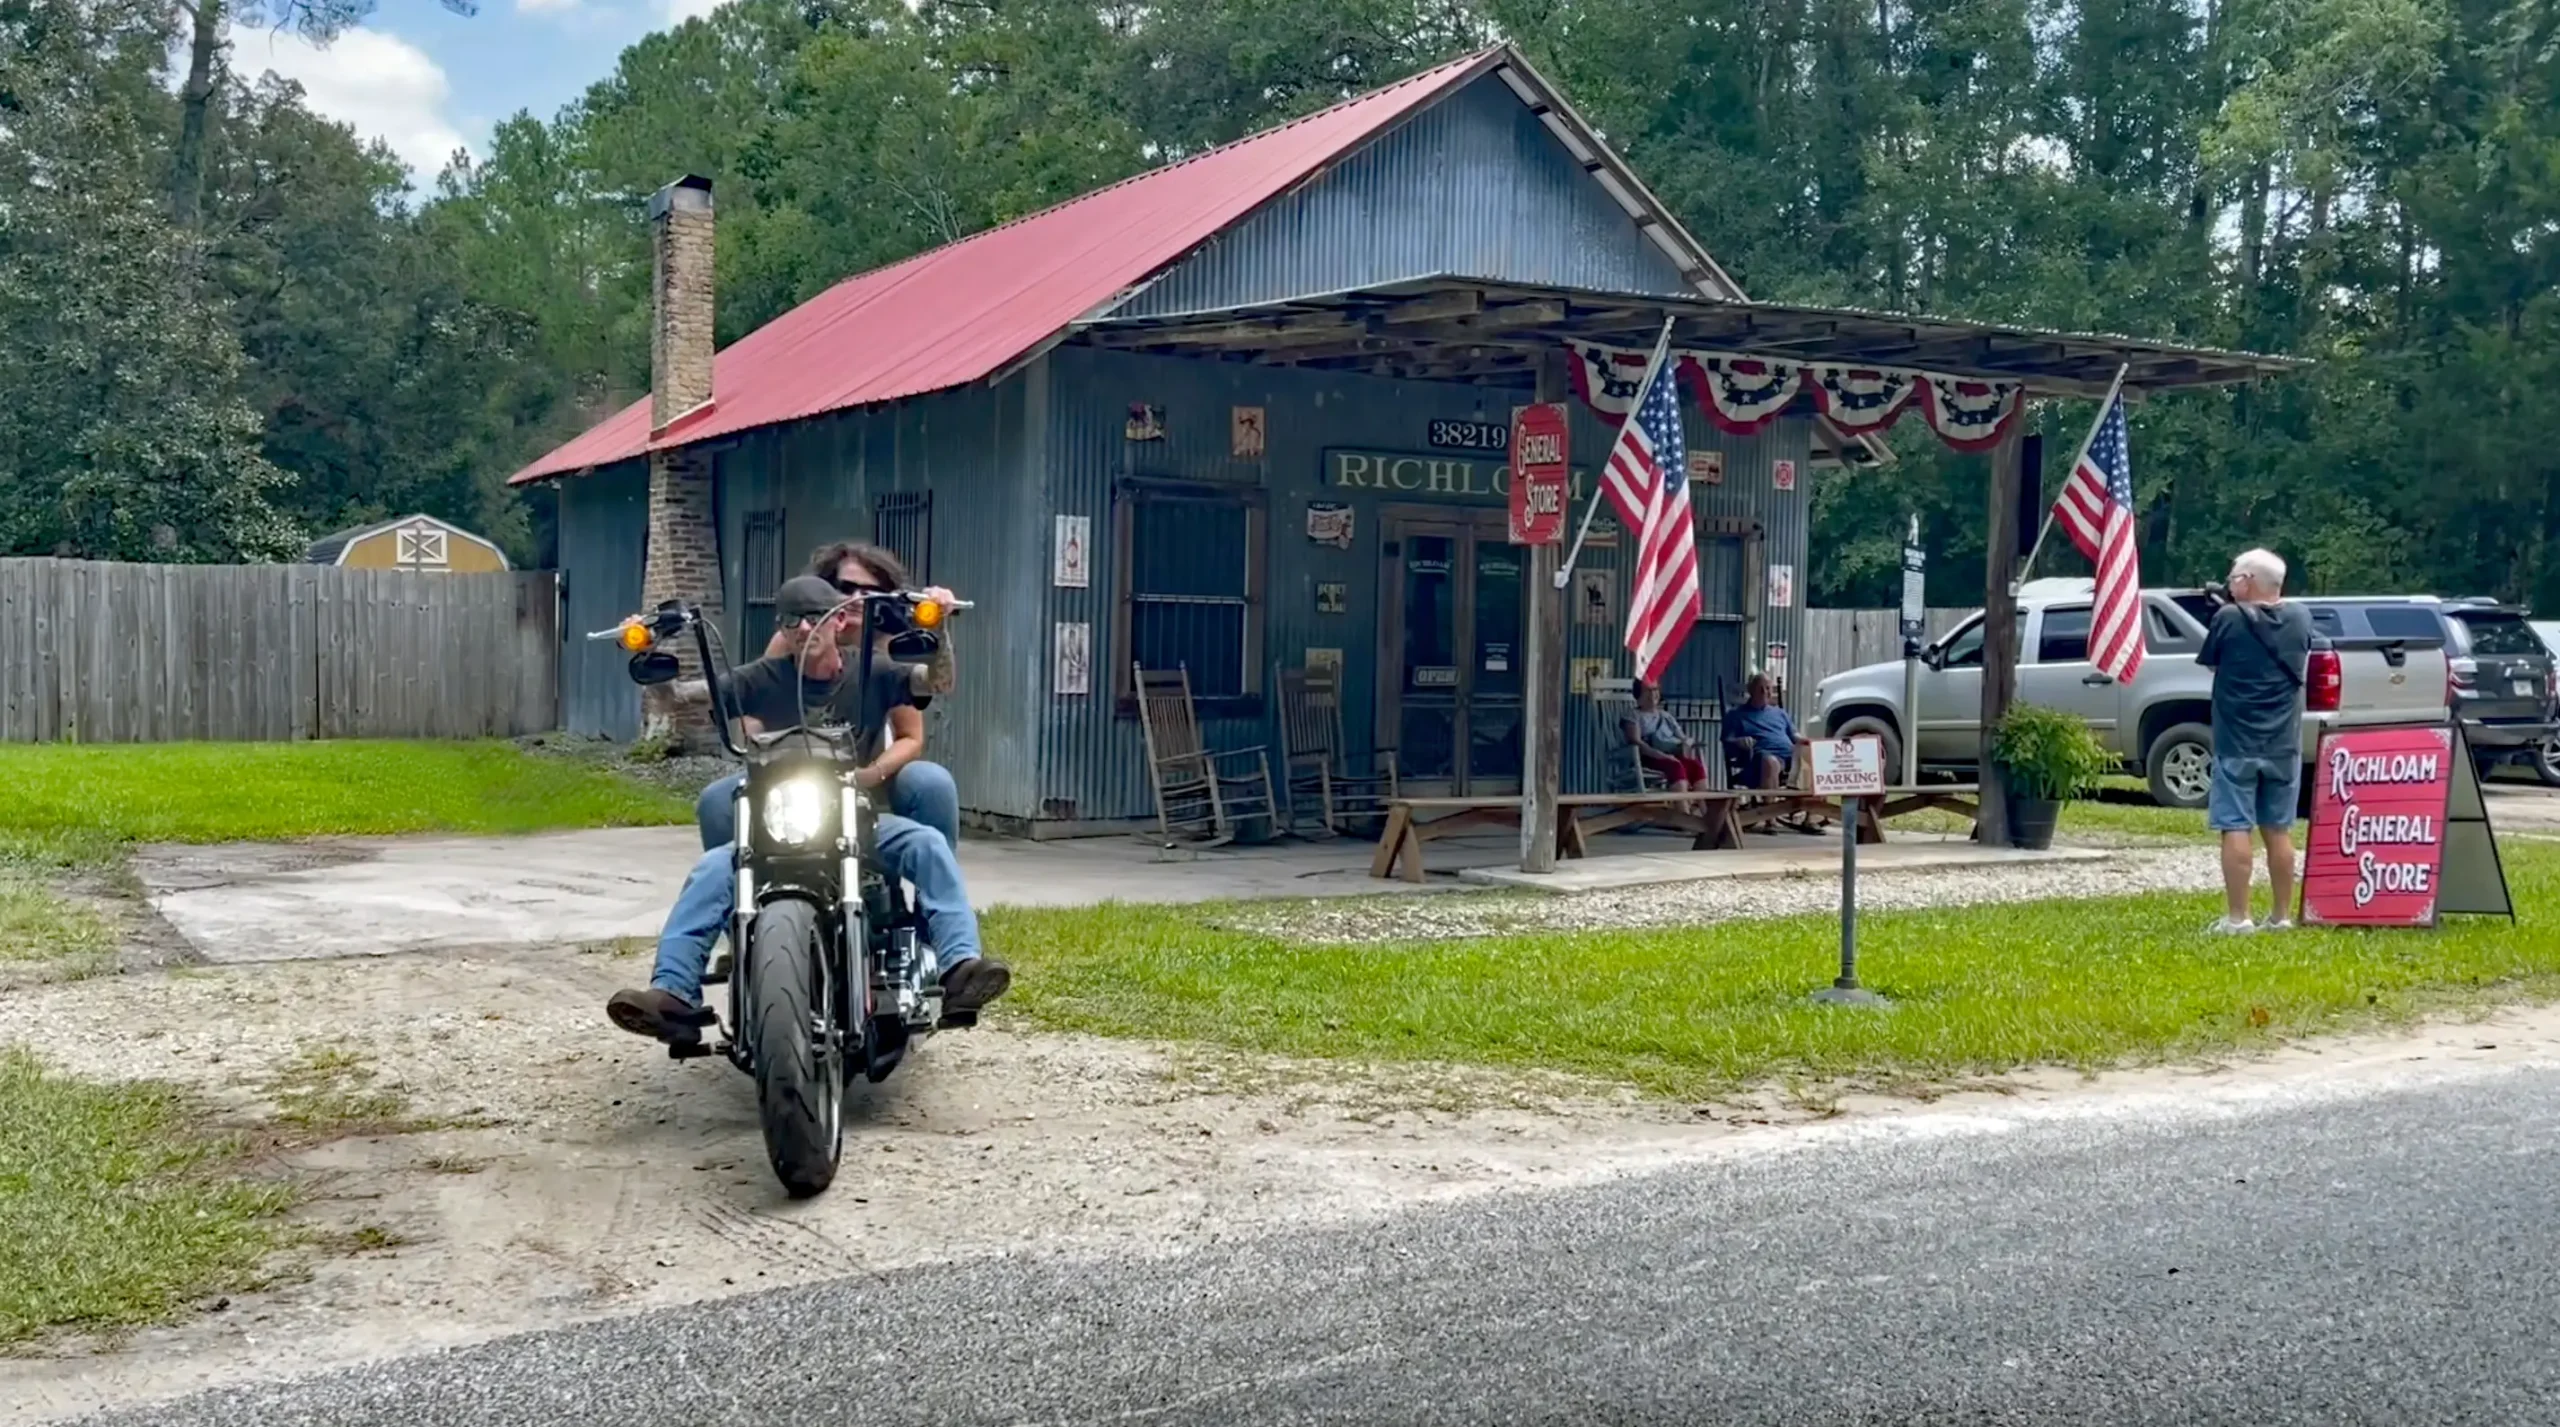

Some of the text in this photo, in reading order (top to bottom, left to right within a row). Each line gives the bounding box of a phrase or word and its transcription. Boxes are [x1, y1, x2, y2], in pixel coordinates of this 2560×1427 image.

[1433, 421, 1507, 448] 38219
[1517, 423, 1562, 476] GENERAL
[1336, 454, 1585, 501] RICHLOM
[1524, 473, 1560, 530] STORE
[1417, 669, 1457, 682] OPEN
[1834, 743, 1855, 754] NO
[1816, 772, 1878, 785] PARKING
[2330, 747, 2437, 803] RICHLOAM
[2341, 804, 2436, 856] GENERAL
[2354, 851, 2431, 908] STORE
